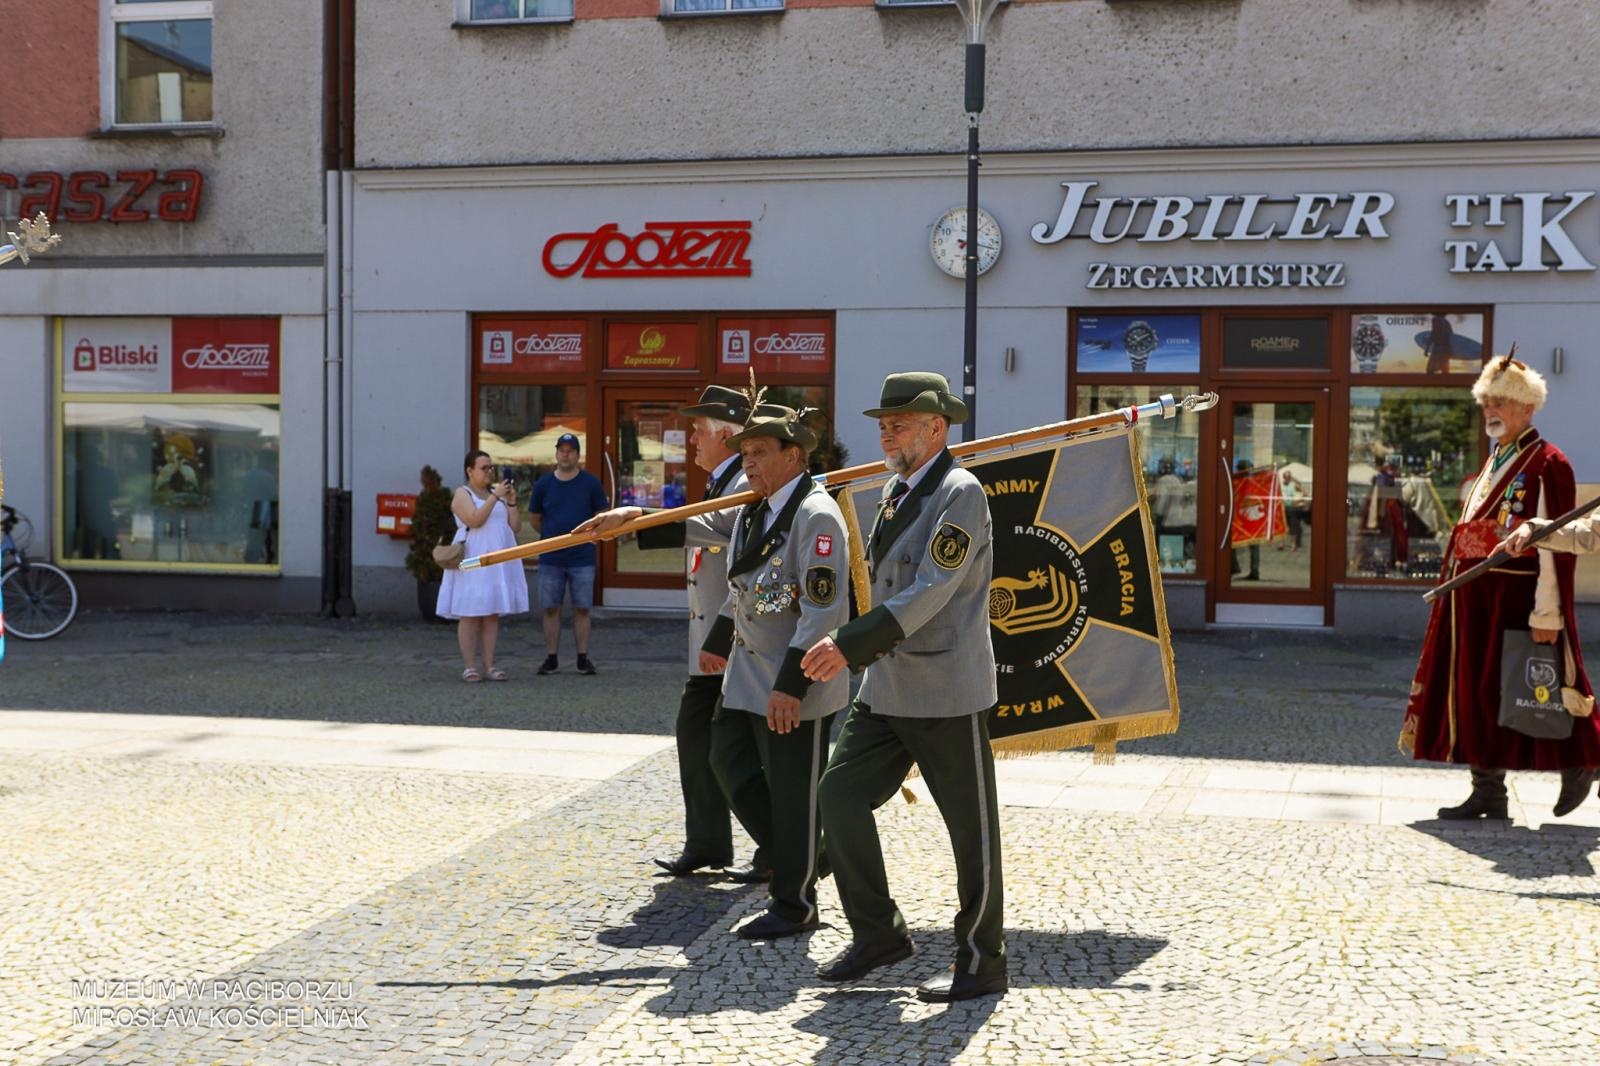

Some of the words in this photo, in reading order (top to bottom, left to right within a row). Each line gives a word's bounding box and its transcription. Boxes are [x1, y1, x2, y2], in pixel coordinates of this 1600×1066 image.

[1031, 181, 1396, 244] JUBILER
[1086, 262, 1346, 290] ZEGARMISTRZ
[1386, 317, 1427, 326] ORIENT
[99, 345, 158, 365] Bliski
[1251, 336, 1300, 349] ROAMER
[624, 356, 675, 367] Zapraszamy
[1014, 525, 1089, 594] RACIBORSKIE
[1109, 538, 1135, 617] BRACIA
[1034, 604, 1088, 668] KURKOWE
[997, 694, 1065, 717] WRAZ
